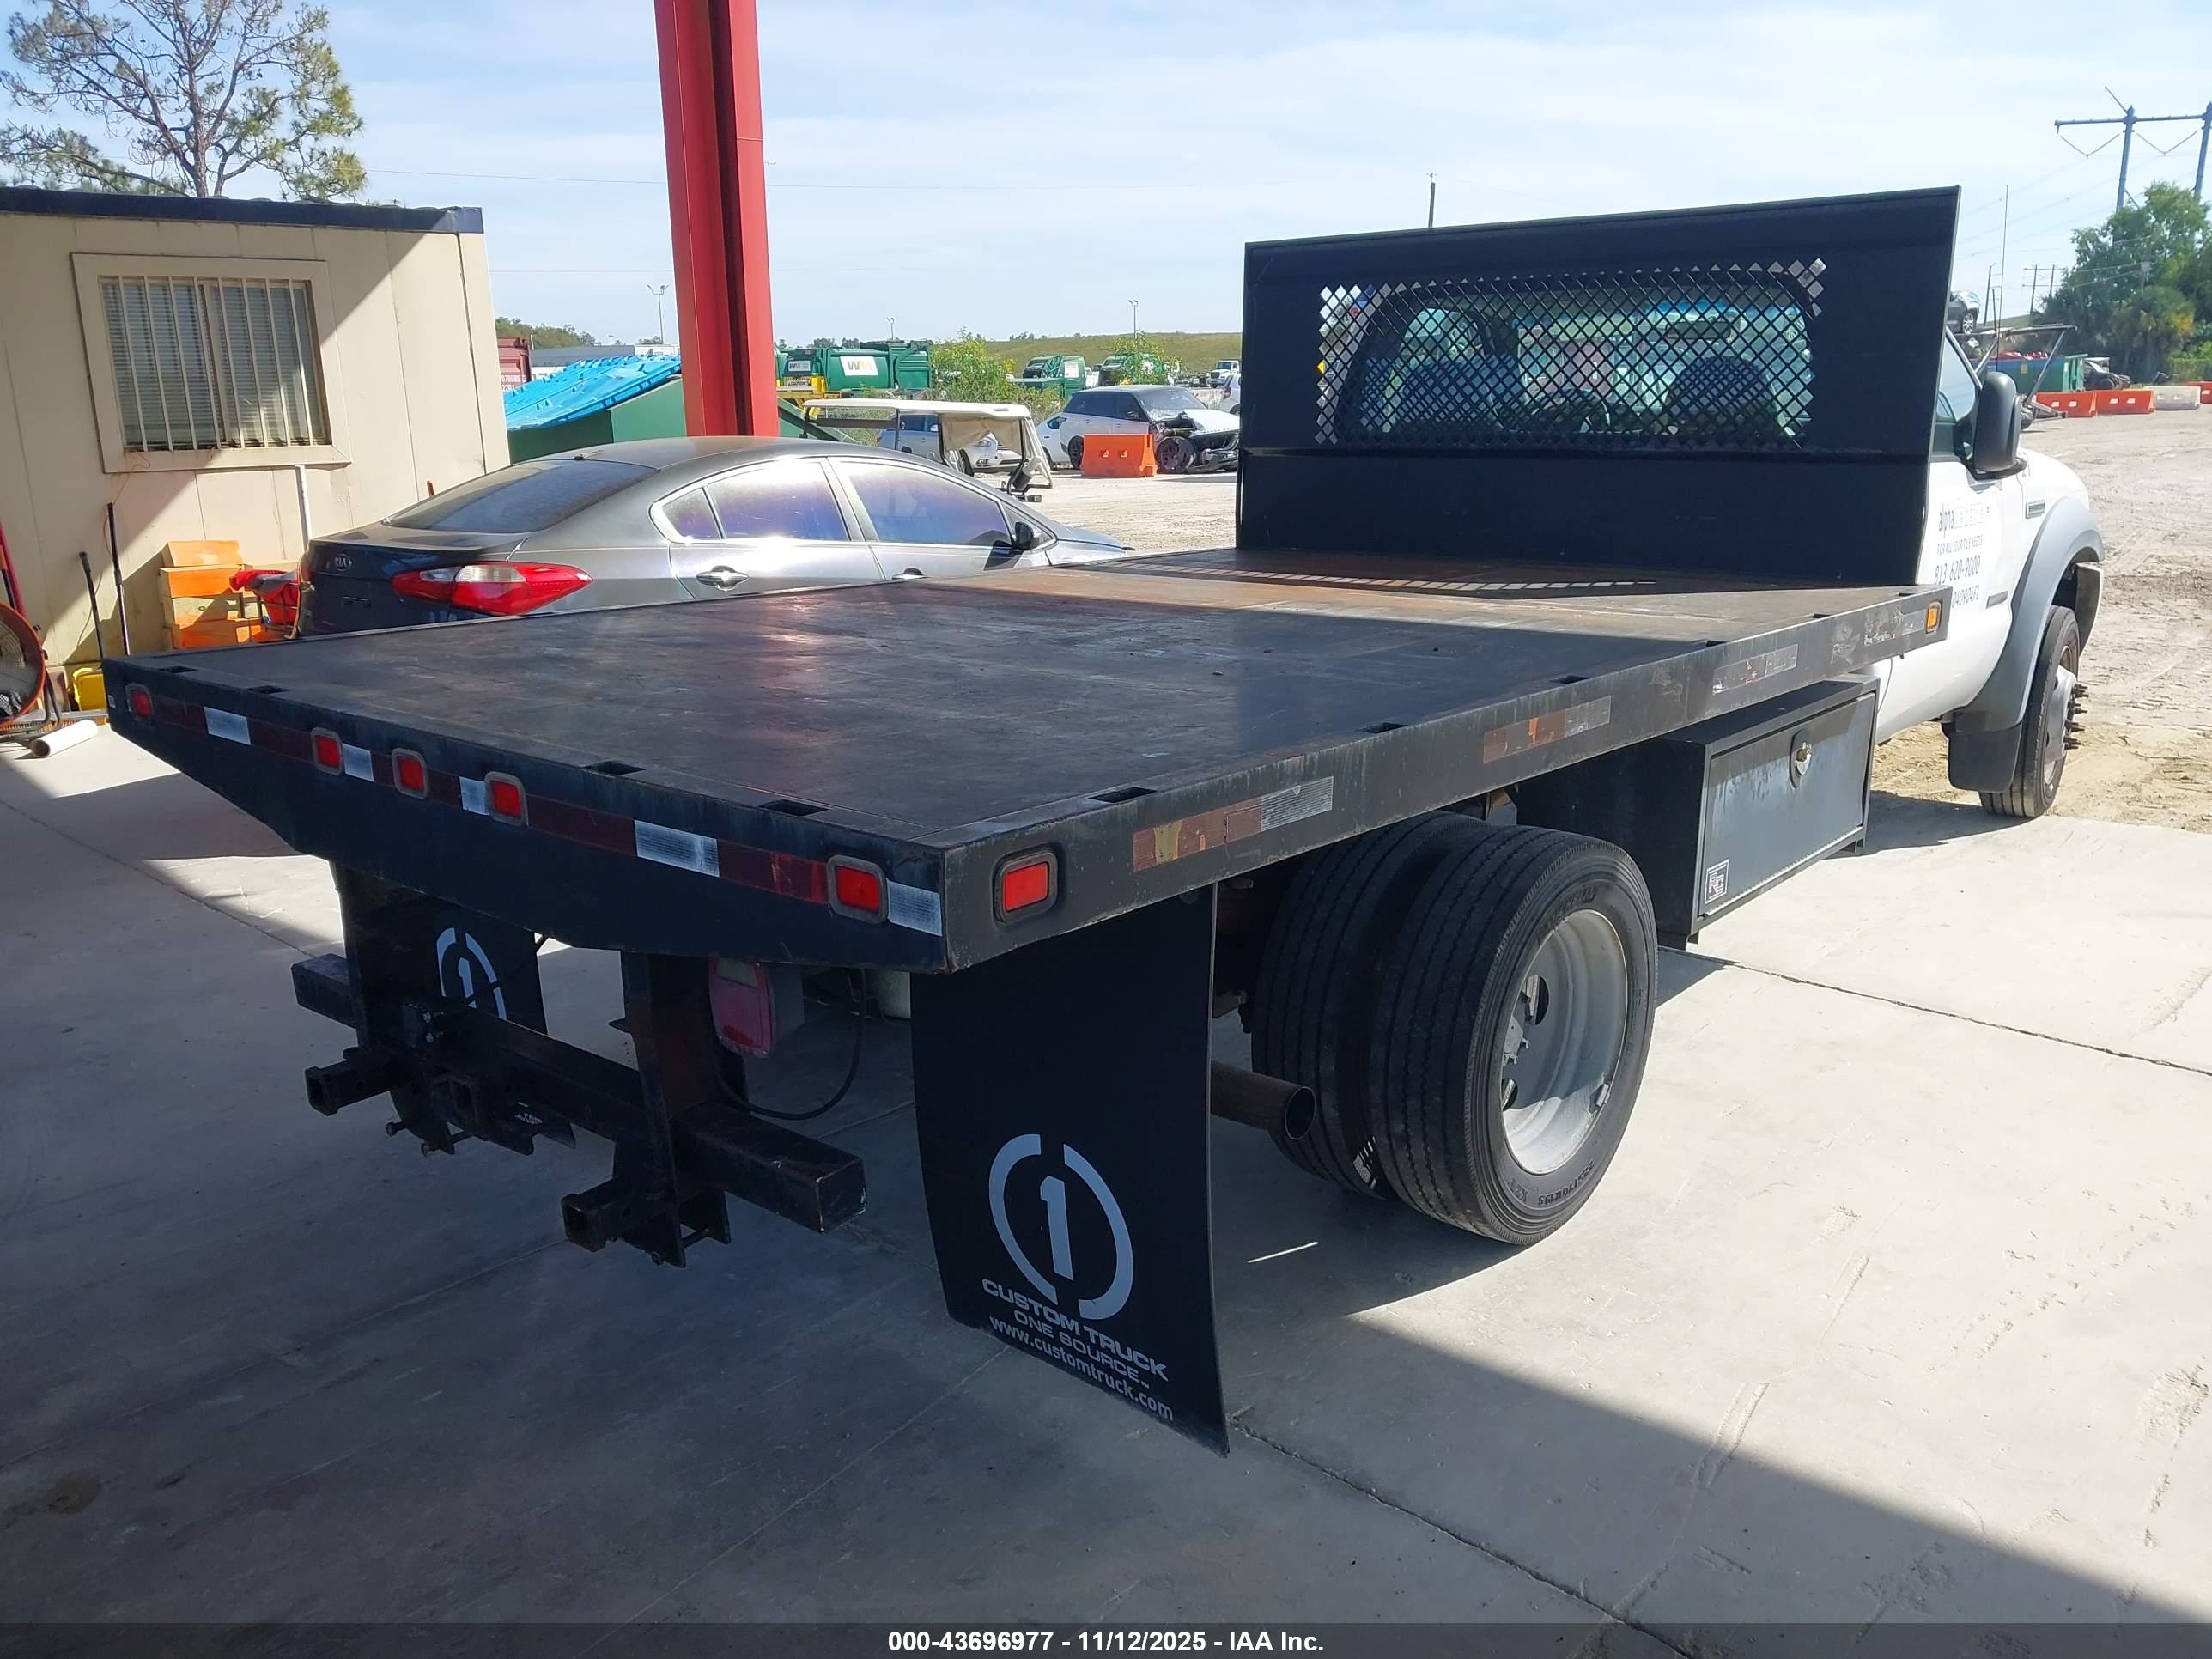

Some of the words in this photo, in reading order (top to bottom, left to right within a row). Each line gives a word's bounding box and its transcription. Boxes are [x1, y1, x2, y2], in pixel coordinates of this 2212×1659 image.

[1934, 554, 1981, 585] 813-620-9000
[981, 1277, 1081, 1337] CUSTOM
[1083, 1325, 1169, 1382] TRUCK
[1013, 1310, 1055, 1339] ONE
[989, 1316, 1175, 1422] www.customtruck.com
